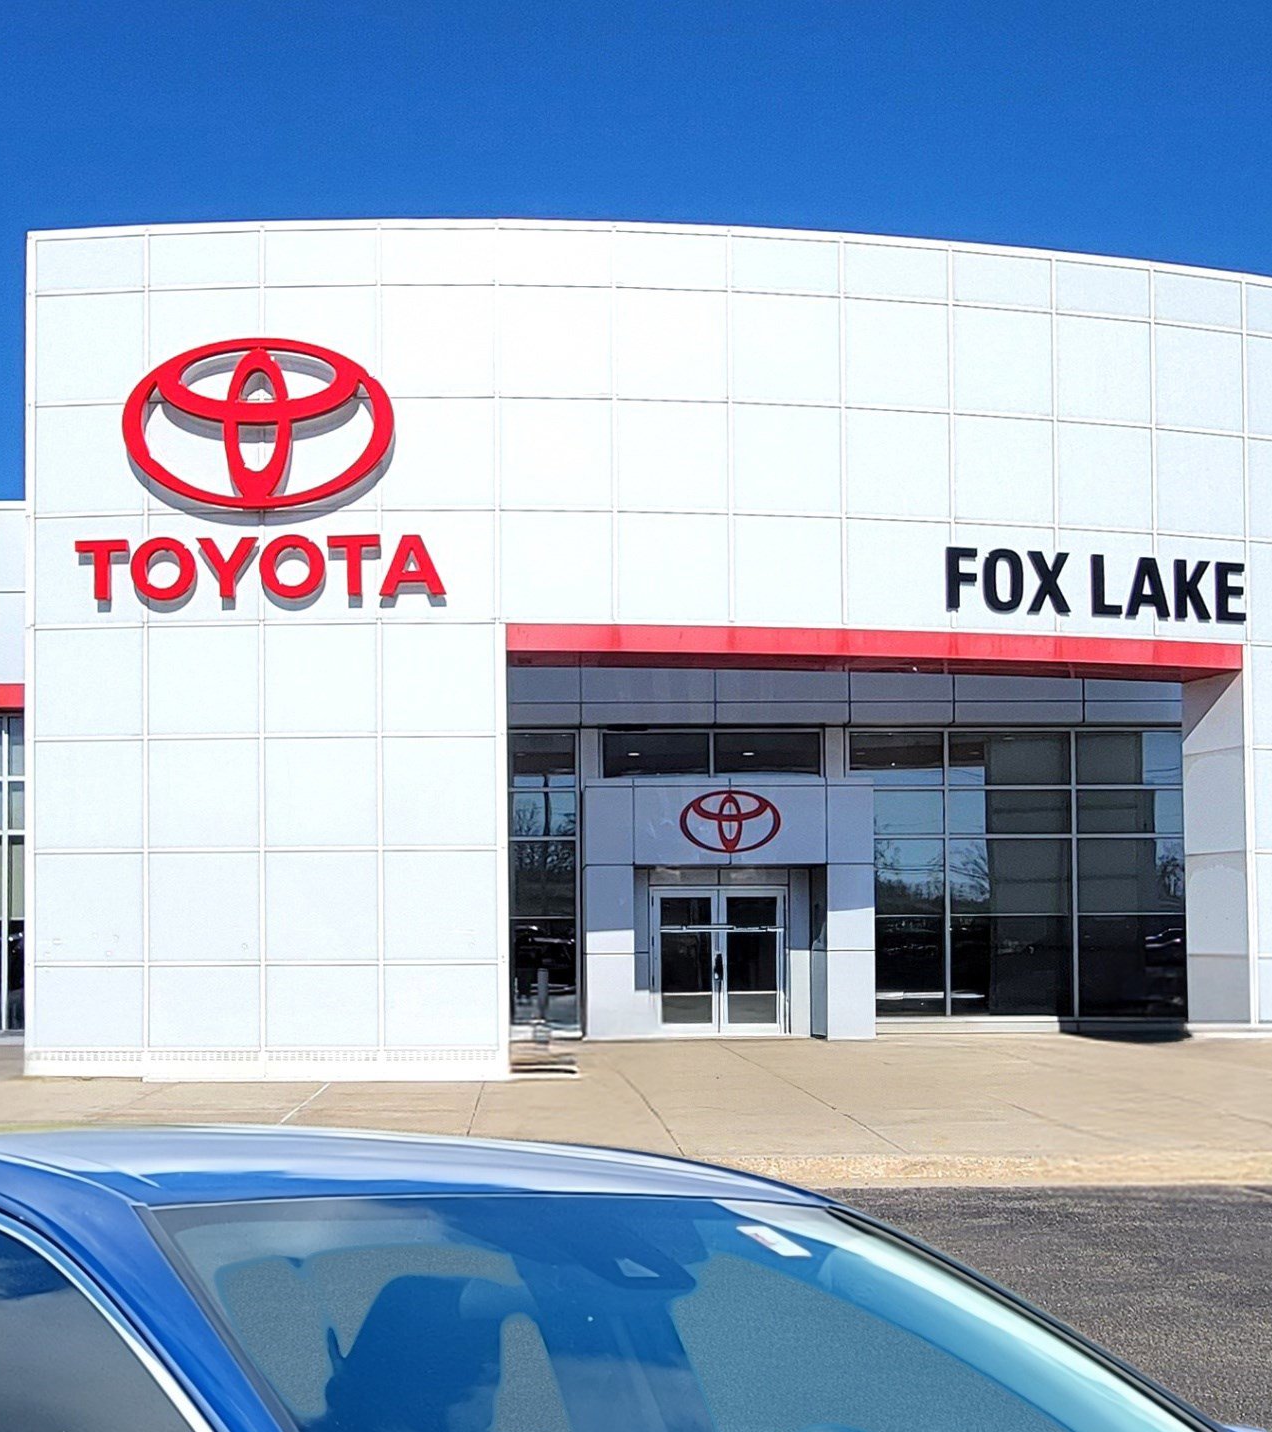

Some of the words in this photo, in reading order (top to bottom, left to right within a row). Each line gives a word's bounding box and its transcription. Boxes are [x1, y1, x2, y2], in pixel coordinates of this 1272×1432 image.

[74, 534, 446, 604] TOYOTA
[946, 546, 1071, 615] FOX
[1090, 554, 1247, 624] LAKE
